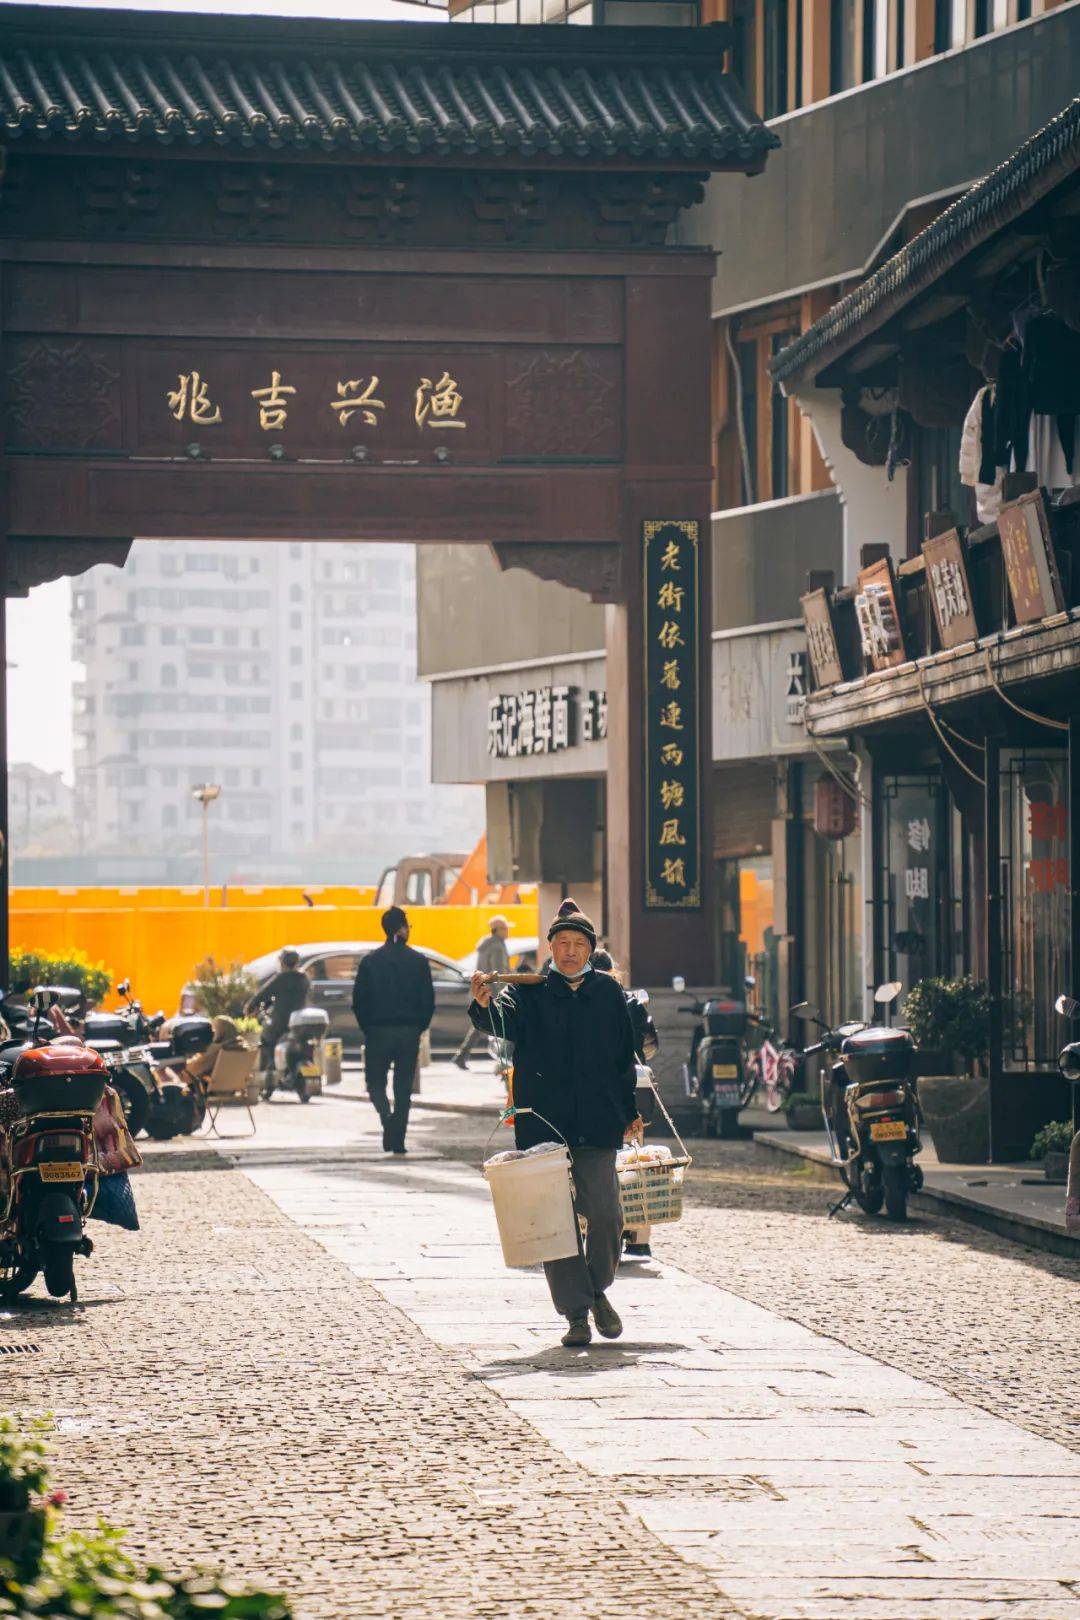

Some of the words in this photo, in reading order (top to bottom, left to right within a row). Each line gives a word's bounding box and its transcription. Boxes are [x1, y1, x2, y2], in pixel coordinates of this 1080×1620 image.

[487, 685, 569, 758] 乐记海鲜面
